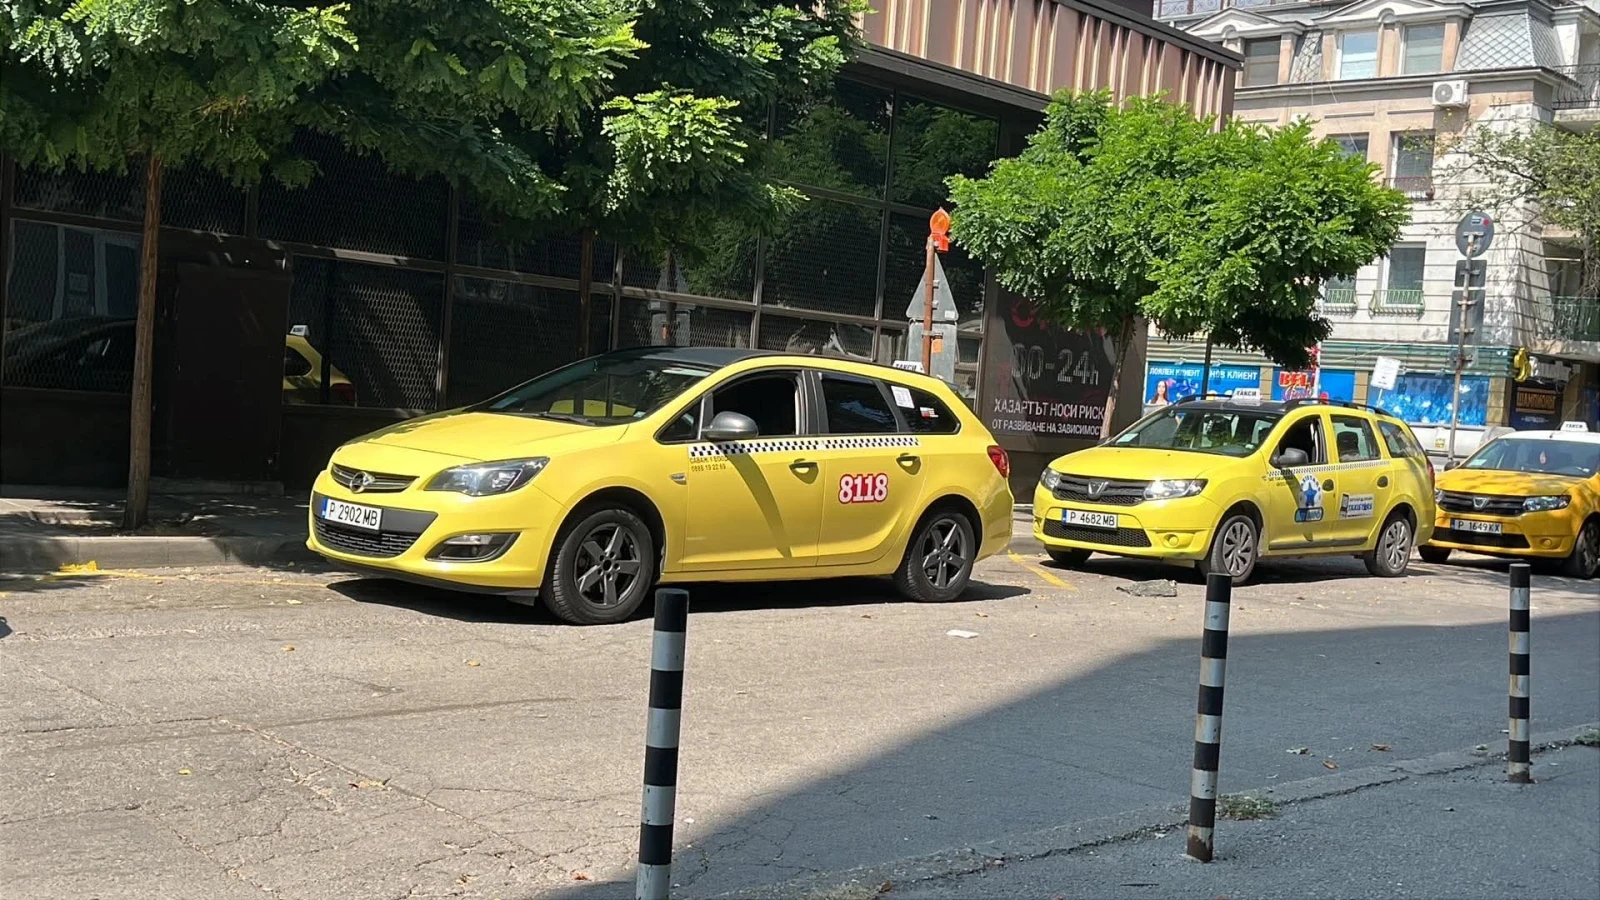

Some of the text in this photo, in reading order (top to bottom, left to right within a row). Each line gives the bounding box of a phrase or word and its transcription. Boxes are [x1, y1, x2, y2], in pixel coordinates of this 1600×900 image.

[1227, 370, 1258, 380] КЛИЕНТ
[994, 398, 1105, 420] ХАЗАРТЪТ НОСИ РИСК
[992, 419, 1002, 430] ОТ
[1003, 419, 1046, 433] РАЗВИВАНЕ
[1046, 422, 1057, 433] НА
[838, 473, 888, 504] 8118
[338, 504, 362, 523] 2902
[1080, 513, 1102, 525] 4682
[1469, 521, 1488, 531] 1649
